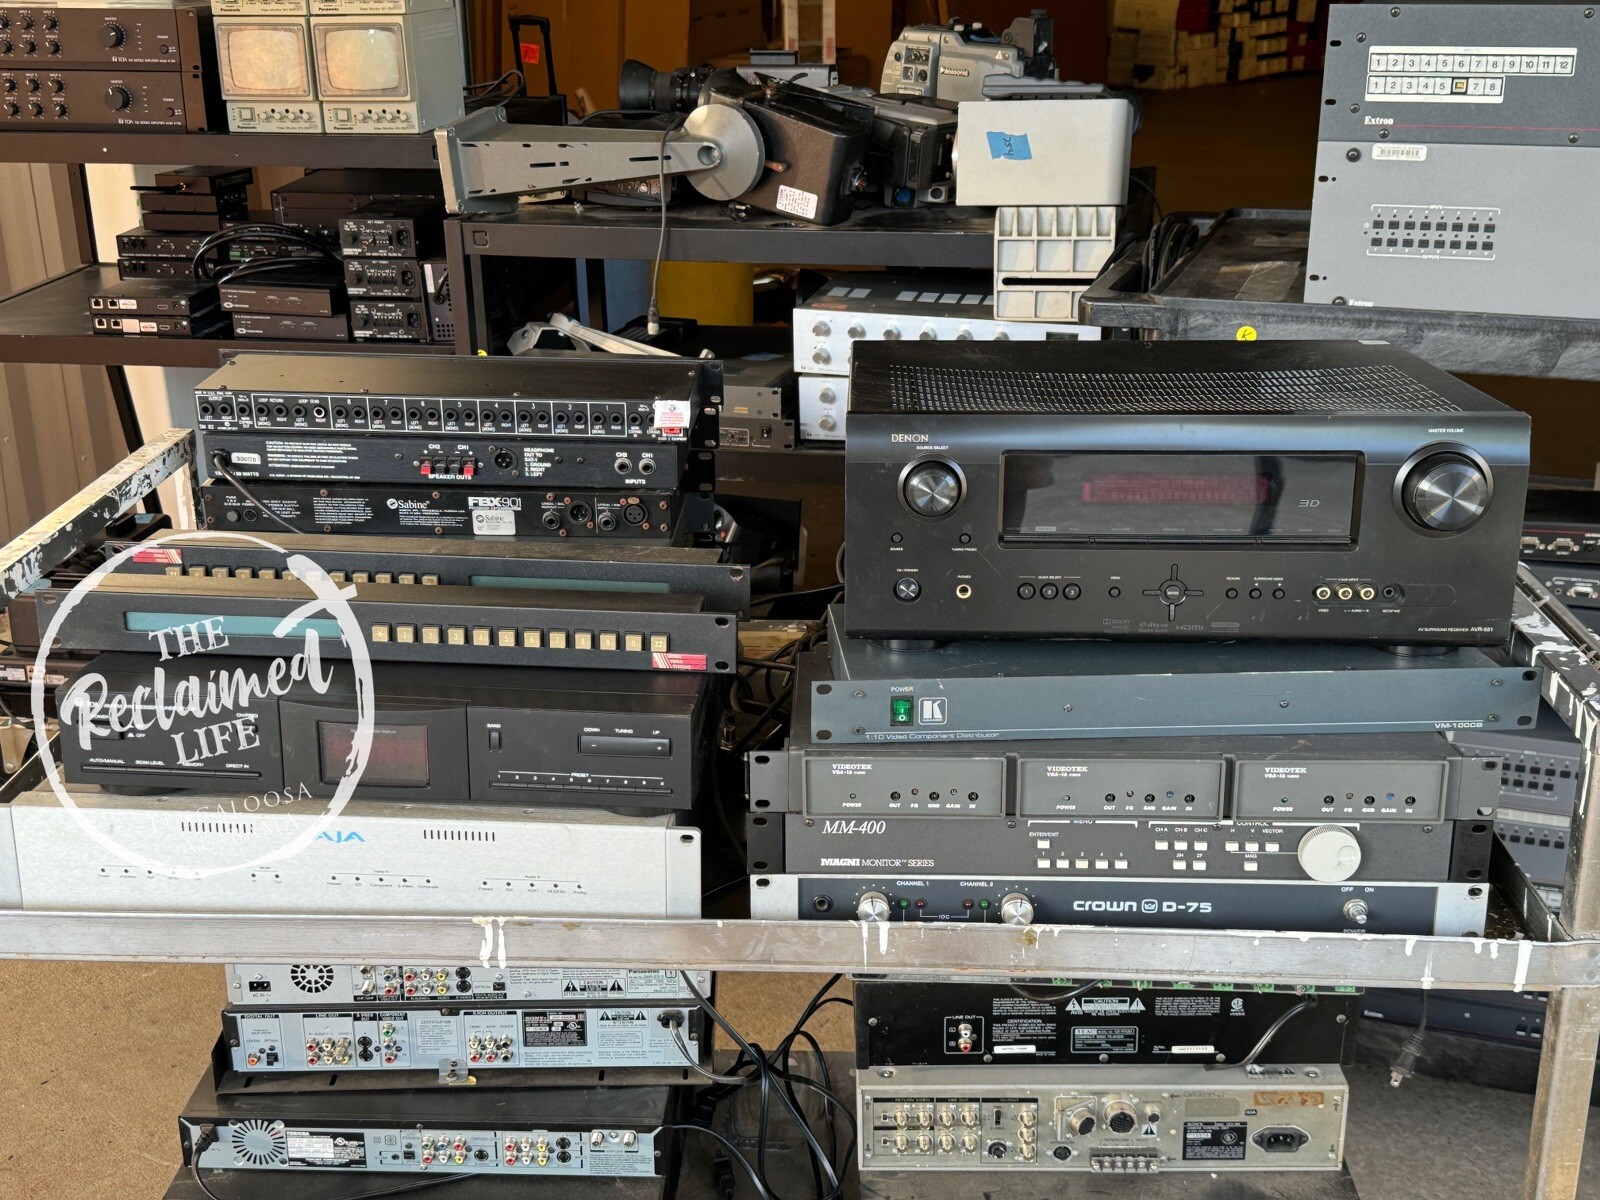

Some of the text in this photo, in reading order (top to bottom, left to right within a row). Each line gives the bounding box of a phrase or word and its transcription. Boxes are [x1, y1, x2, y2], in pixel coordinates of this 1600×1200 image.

[1376, 58, 1569, 69] 1 2 3 4 5 6 7 8 9 10 11 12
[1374, 81, 1496, 91] 1 2 3 4 5 7 8
[1364, 115, 1394, 126] Extron
[891, 434, 929, 443] DENON
[398, 500, 428, 509] Sabine
[1298, 500, 1320, 508] 3D
[909, 732, 955, 740] Component
[956, 732, 1000, 740] Distributor
[822, 820, 886, 835] MM-400
[315, 830, 366, 843] AJA
[821, 858, 860, 867] MAGNI
[907, 859, 935, 867] SERIES
[1072, 901, 1213, 913] crown D-75
